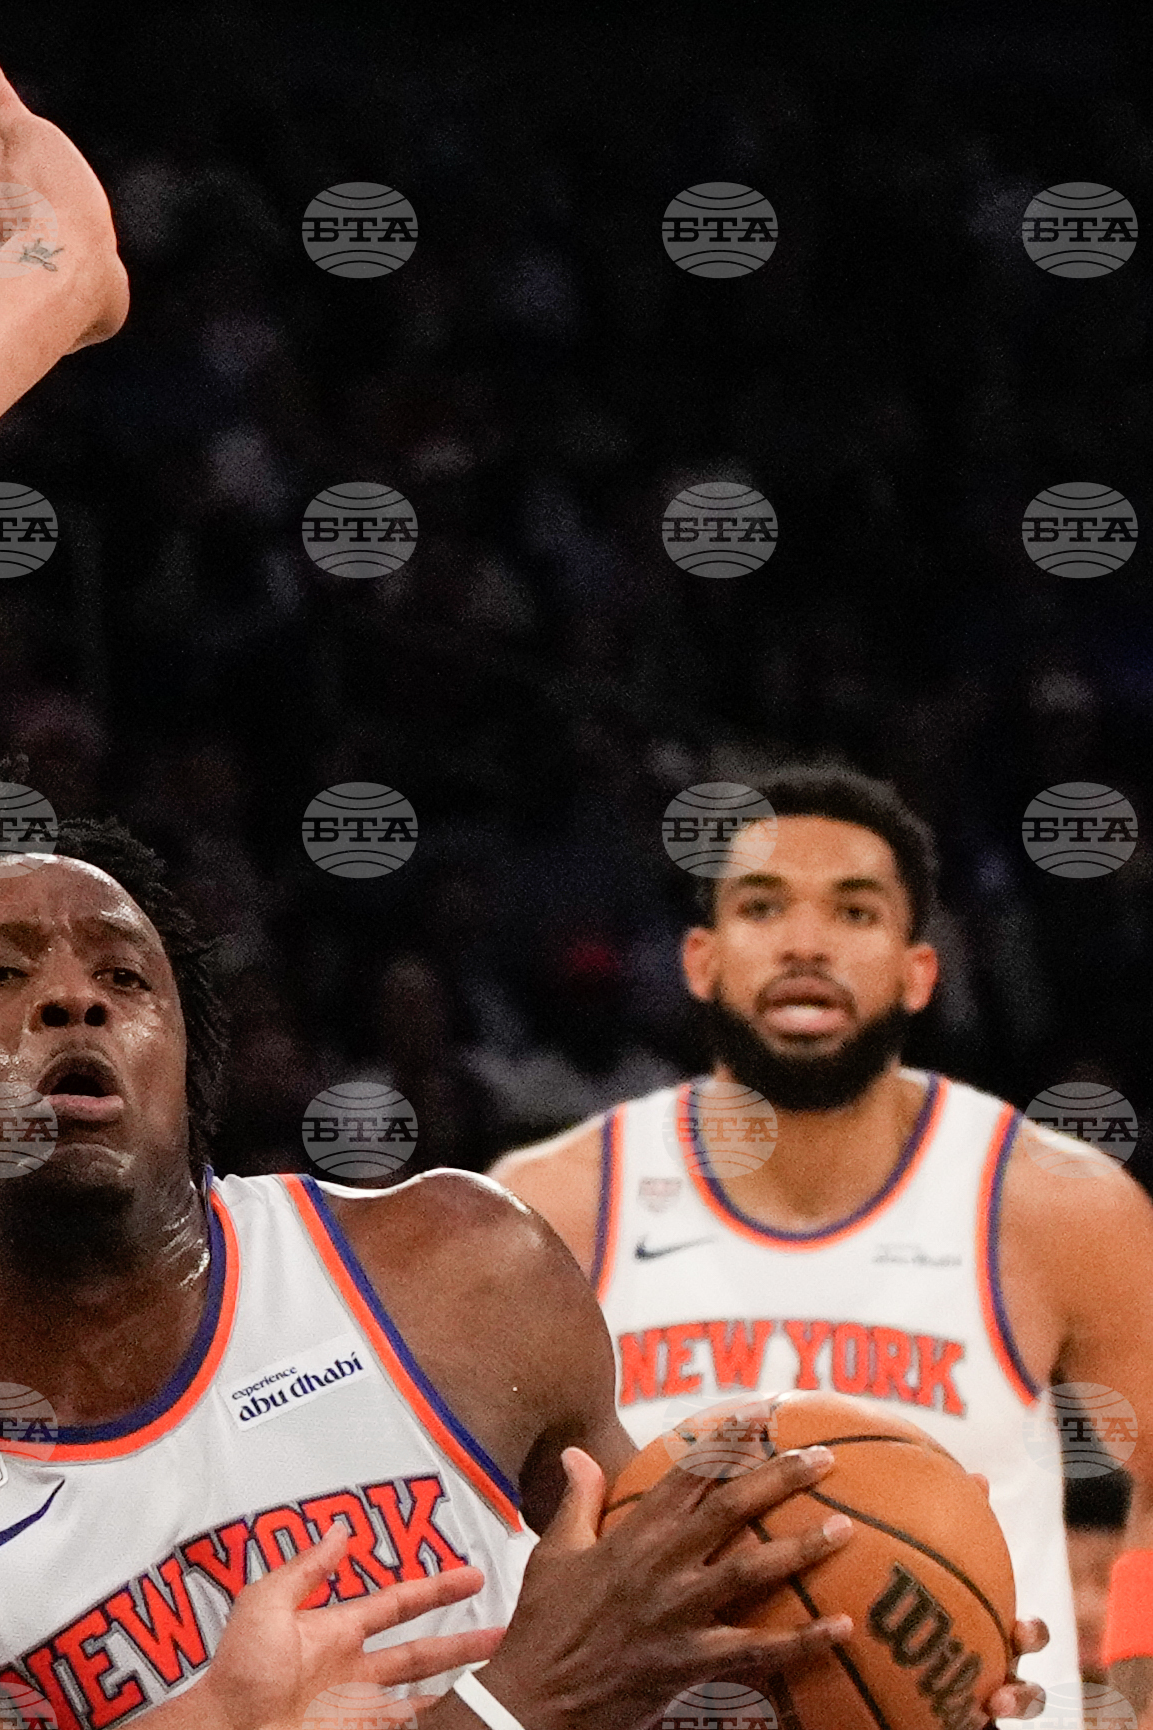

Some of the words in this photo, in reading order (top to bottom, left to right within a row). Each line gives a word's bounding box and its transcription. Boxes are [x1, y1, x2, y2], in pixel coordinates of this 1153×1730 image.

[232, 1366, 298, 1400] experience
[617, 1319, 774, 1407] NEW
[782, 1319, 966, 1417] YORK
[239, 1389, 289, 1421] abu
